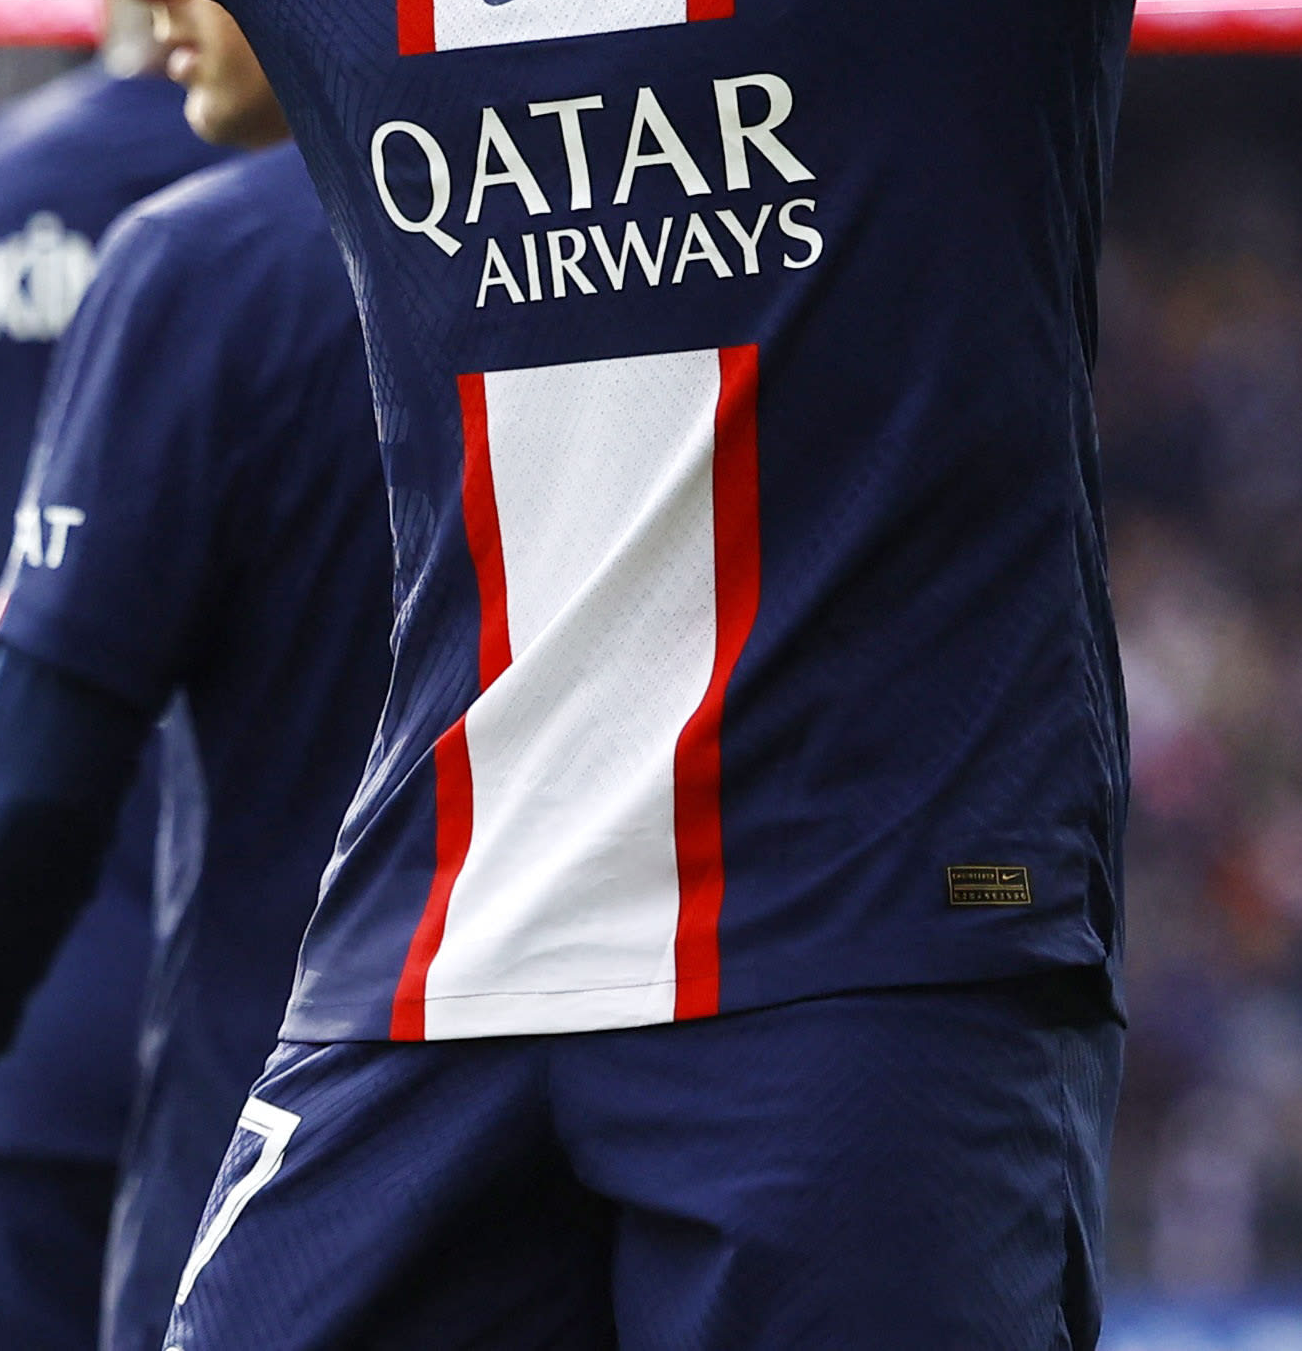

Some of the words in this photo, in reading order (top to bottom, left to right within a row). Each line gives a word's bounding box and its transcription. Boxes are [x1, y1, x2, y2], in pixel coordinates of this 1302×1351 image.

[370, 73, 817, 257] QATAR
[475, 197, 824, 308] AIRWAYS
[174, 1095, 302, 1306] 7
